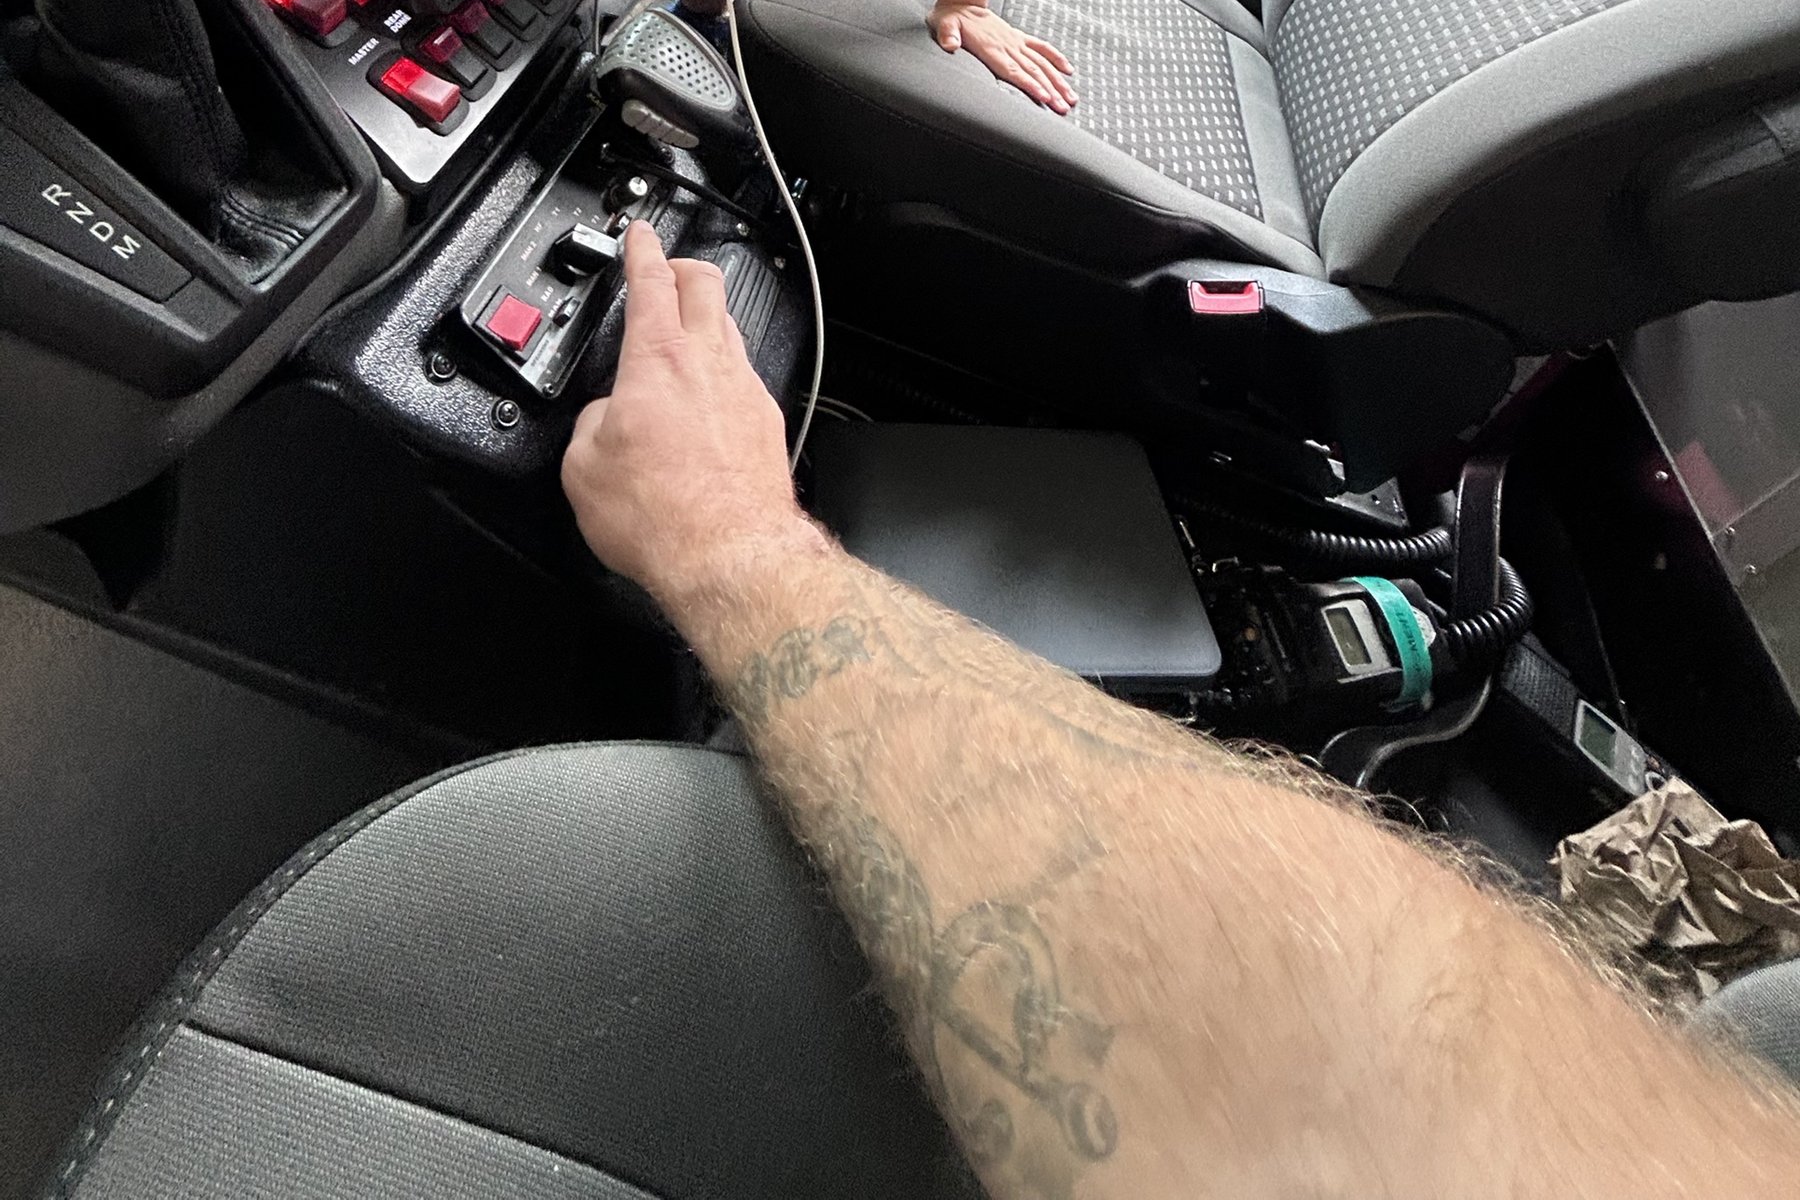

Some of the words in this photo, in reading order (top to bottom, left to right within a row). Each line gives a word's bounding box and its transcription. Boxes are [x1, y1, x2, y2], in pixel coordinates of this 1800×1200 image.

[348, 37, 380, 66] MASTER
[41, 184, 72, 206] R
[65, 201, 94, 224] N
[89, 221, 115, 242] D
[111, 234, 141, 259] M
